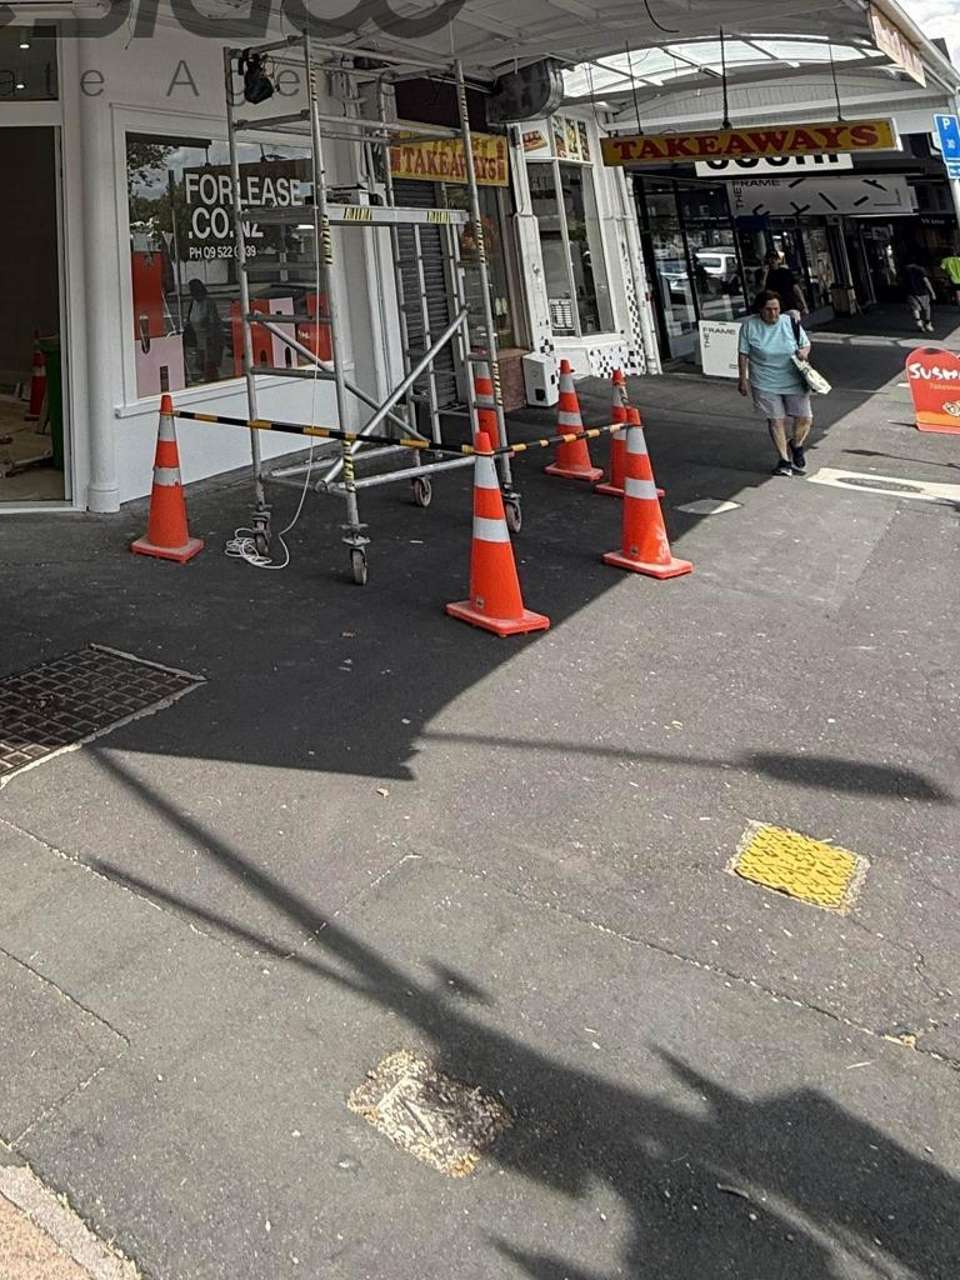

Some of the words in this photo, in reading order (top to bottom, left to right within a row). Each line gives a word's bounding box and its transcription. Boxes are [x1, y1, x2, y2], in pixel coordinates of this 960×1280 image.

[613, 124, 879, 161] TAKEAWAYS
[189, 247, 202, 259] PH
[203, 246, 216, 258] 09
[217, 246, 233, 258] 522
[909, 363, 960, 380] SUSH
